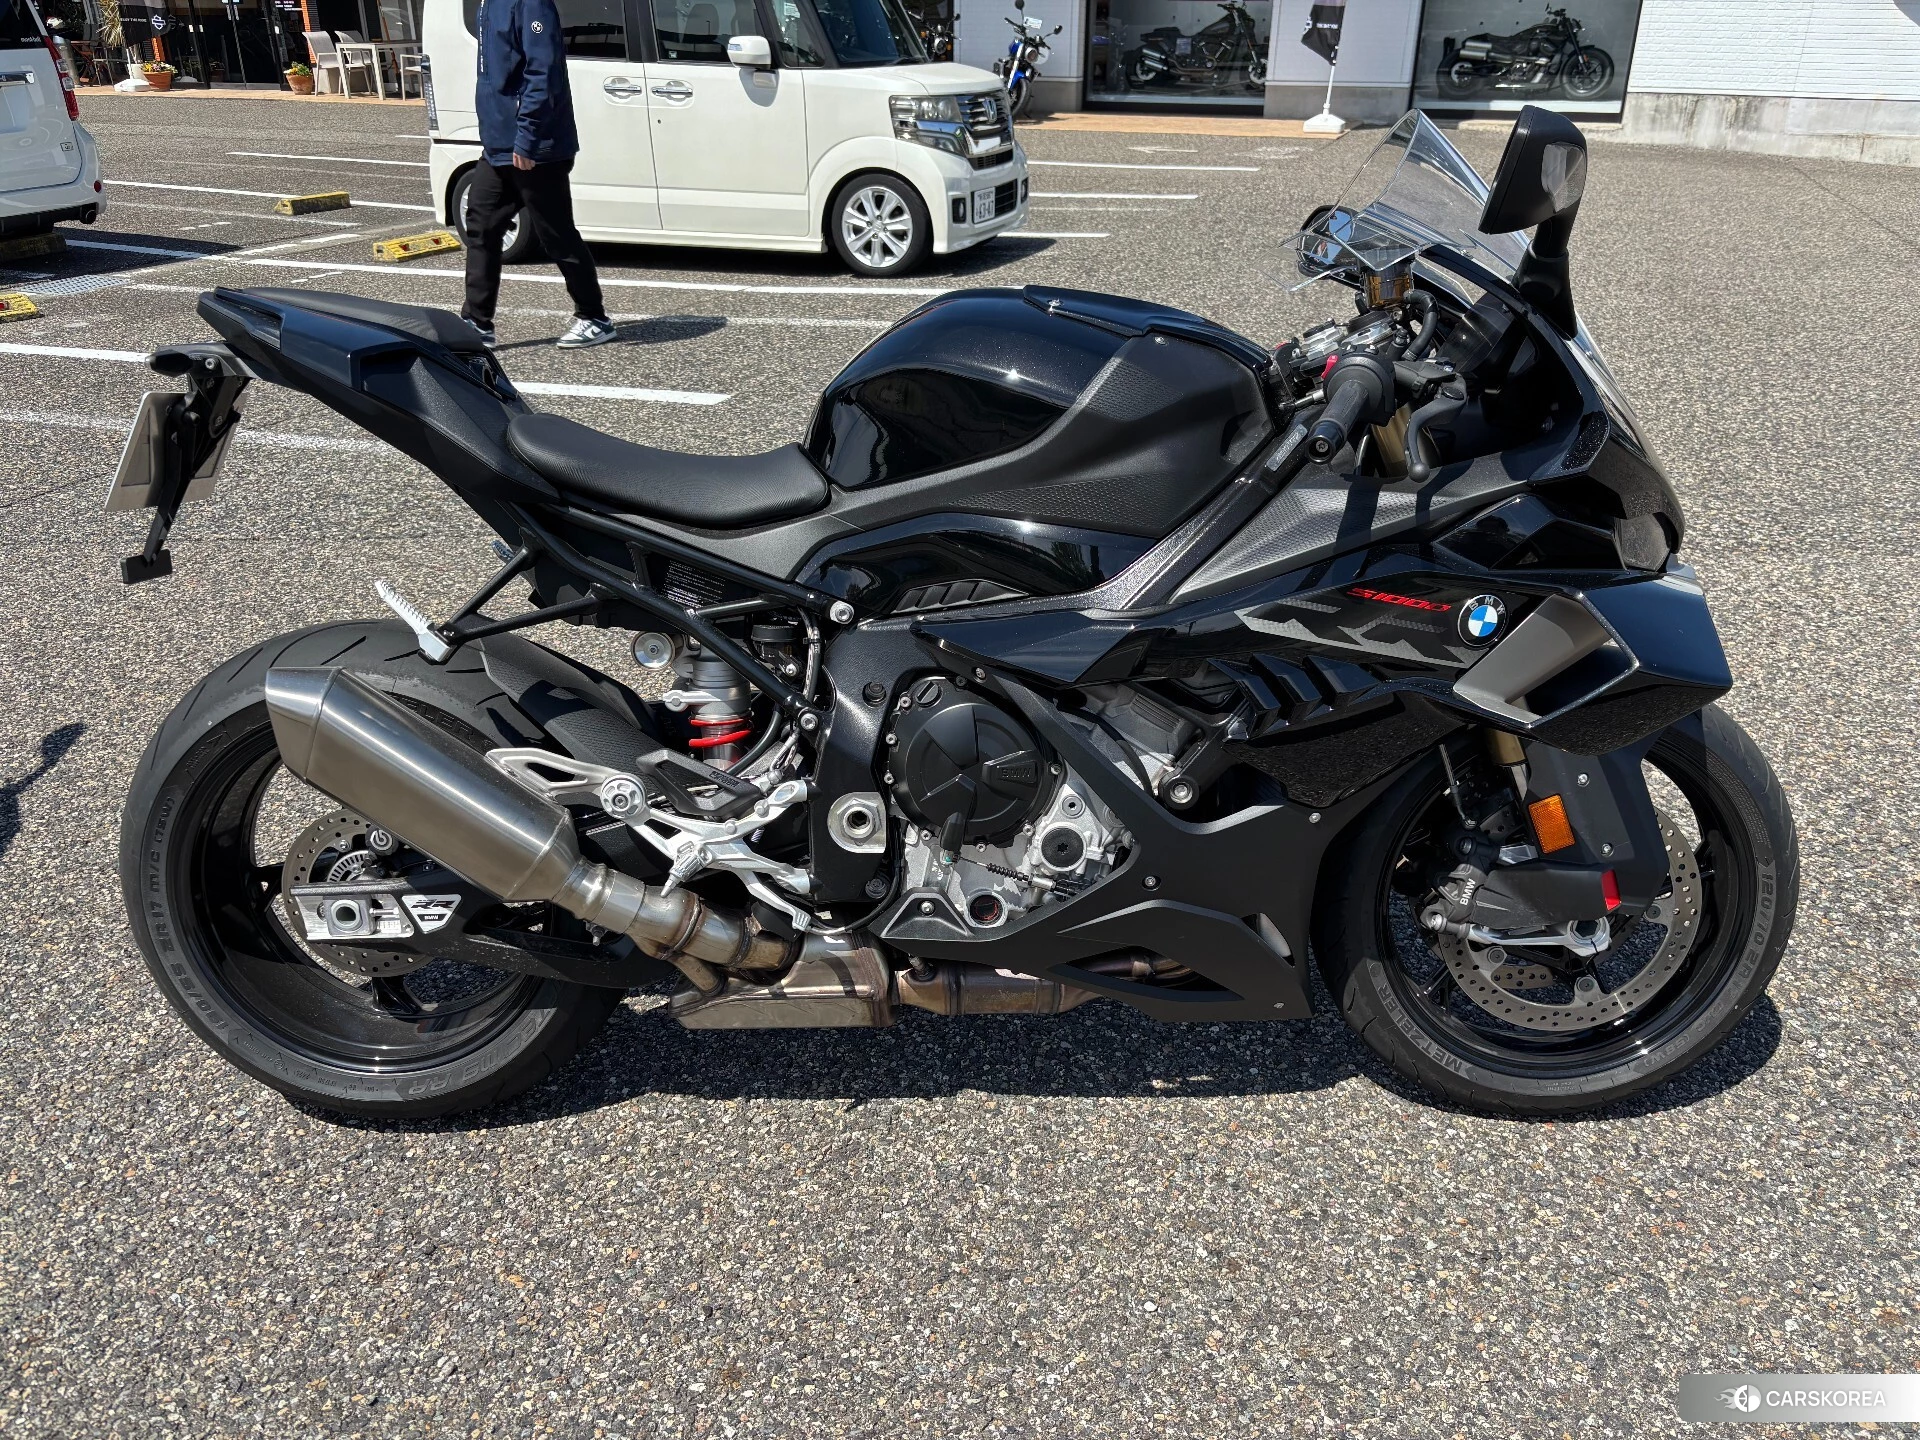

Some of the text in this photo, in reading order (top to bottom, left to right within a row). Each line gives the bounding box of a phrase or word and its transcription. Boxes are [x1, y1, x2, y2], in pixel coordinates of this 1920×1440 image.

[1346, 587, 1452, 612] S1000
[1468, 595, 1506, 616] BMW
[1002, 767, 1031, 778] BMW
[1460, 878, 1476, 905] BMW
[1377, 982, 1463, 1073] METZELER
